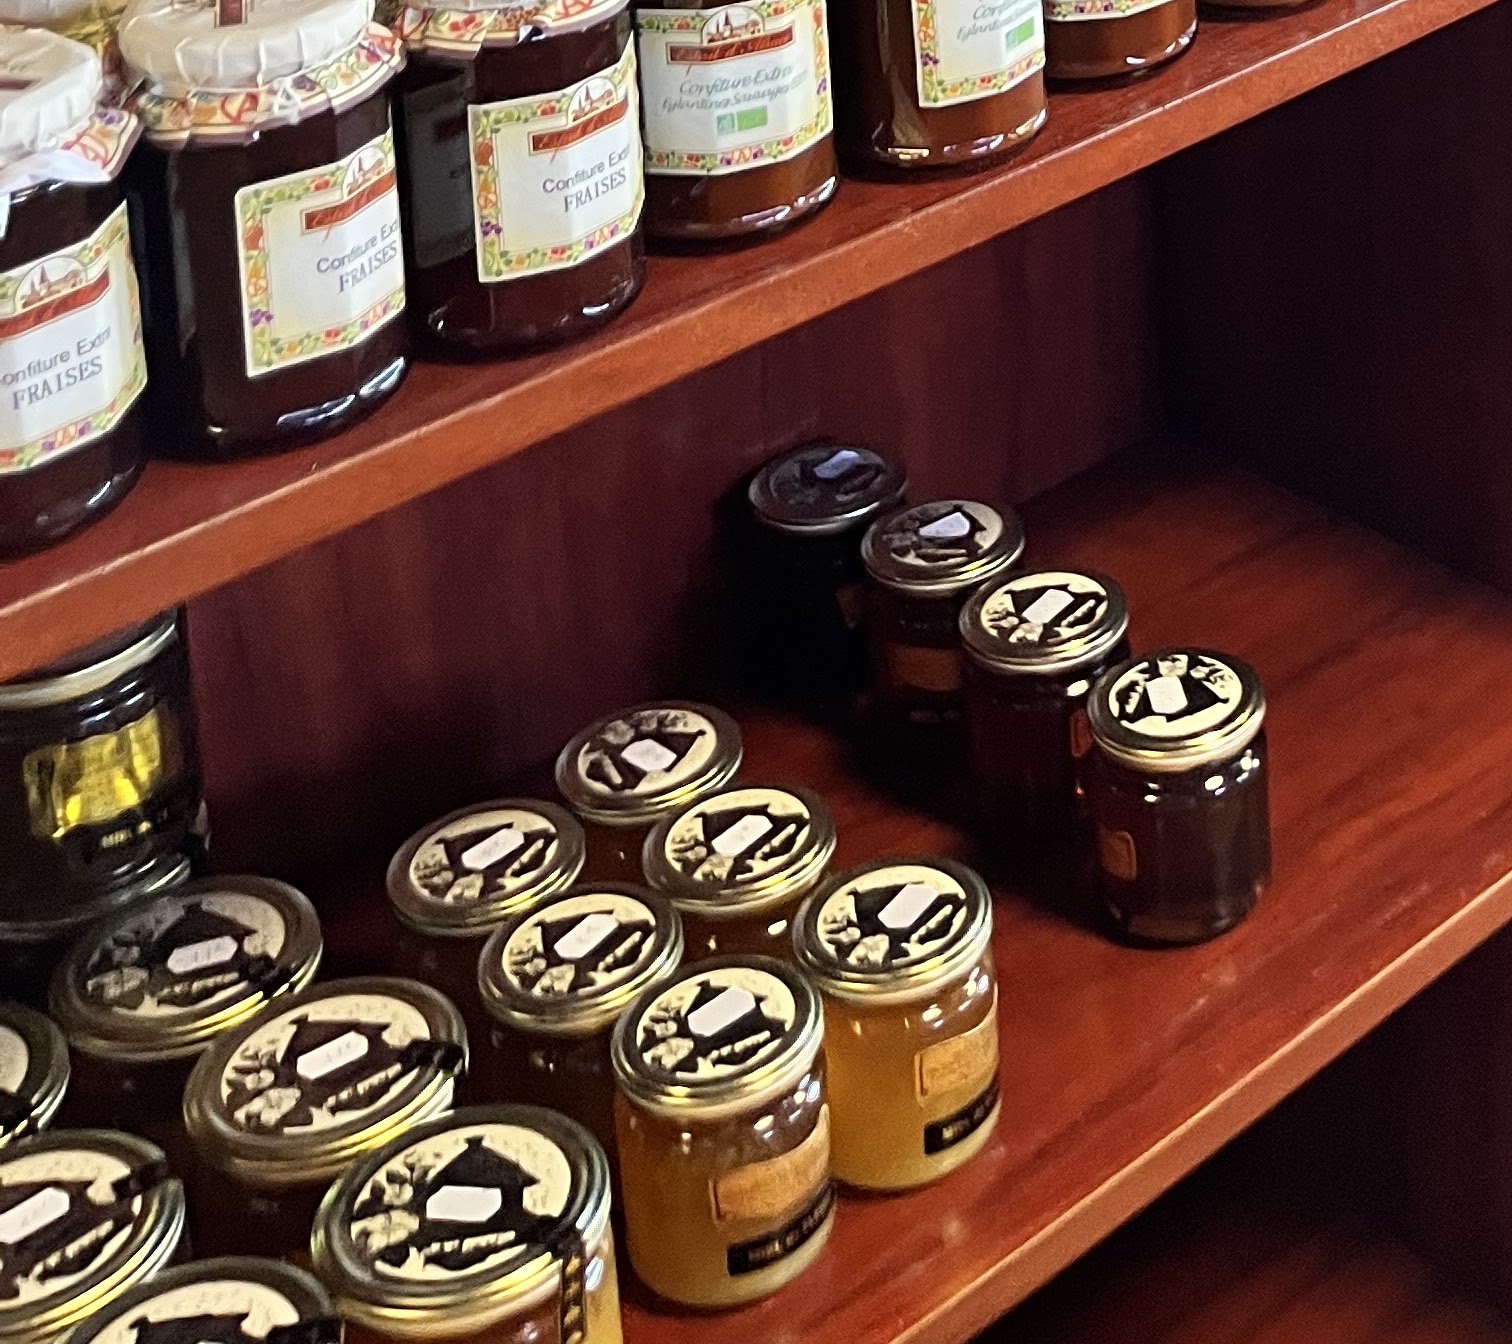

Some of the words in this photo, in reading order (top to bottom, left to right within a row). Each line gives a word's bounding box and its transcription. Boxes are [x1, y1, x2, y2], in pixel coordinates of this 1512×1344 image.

[542, 158, 606, 194] Confiture
[563, 167, 627, 213] FRAISES
[316, 233, 378, 273] Confiture
[338, 239, 398, 294] FRAISES
[1, 349, 71, 386] onfiture
[12, 355, 103, 411] FRAISES
